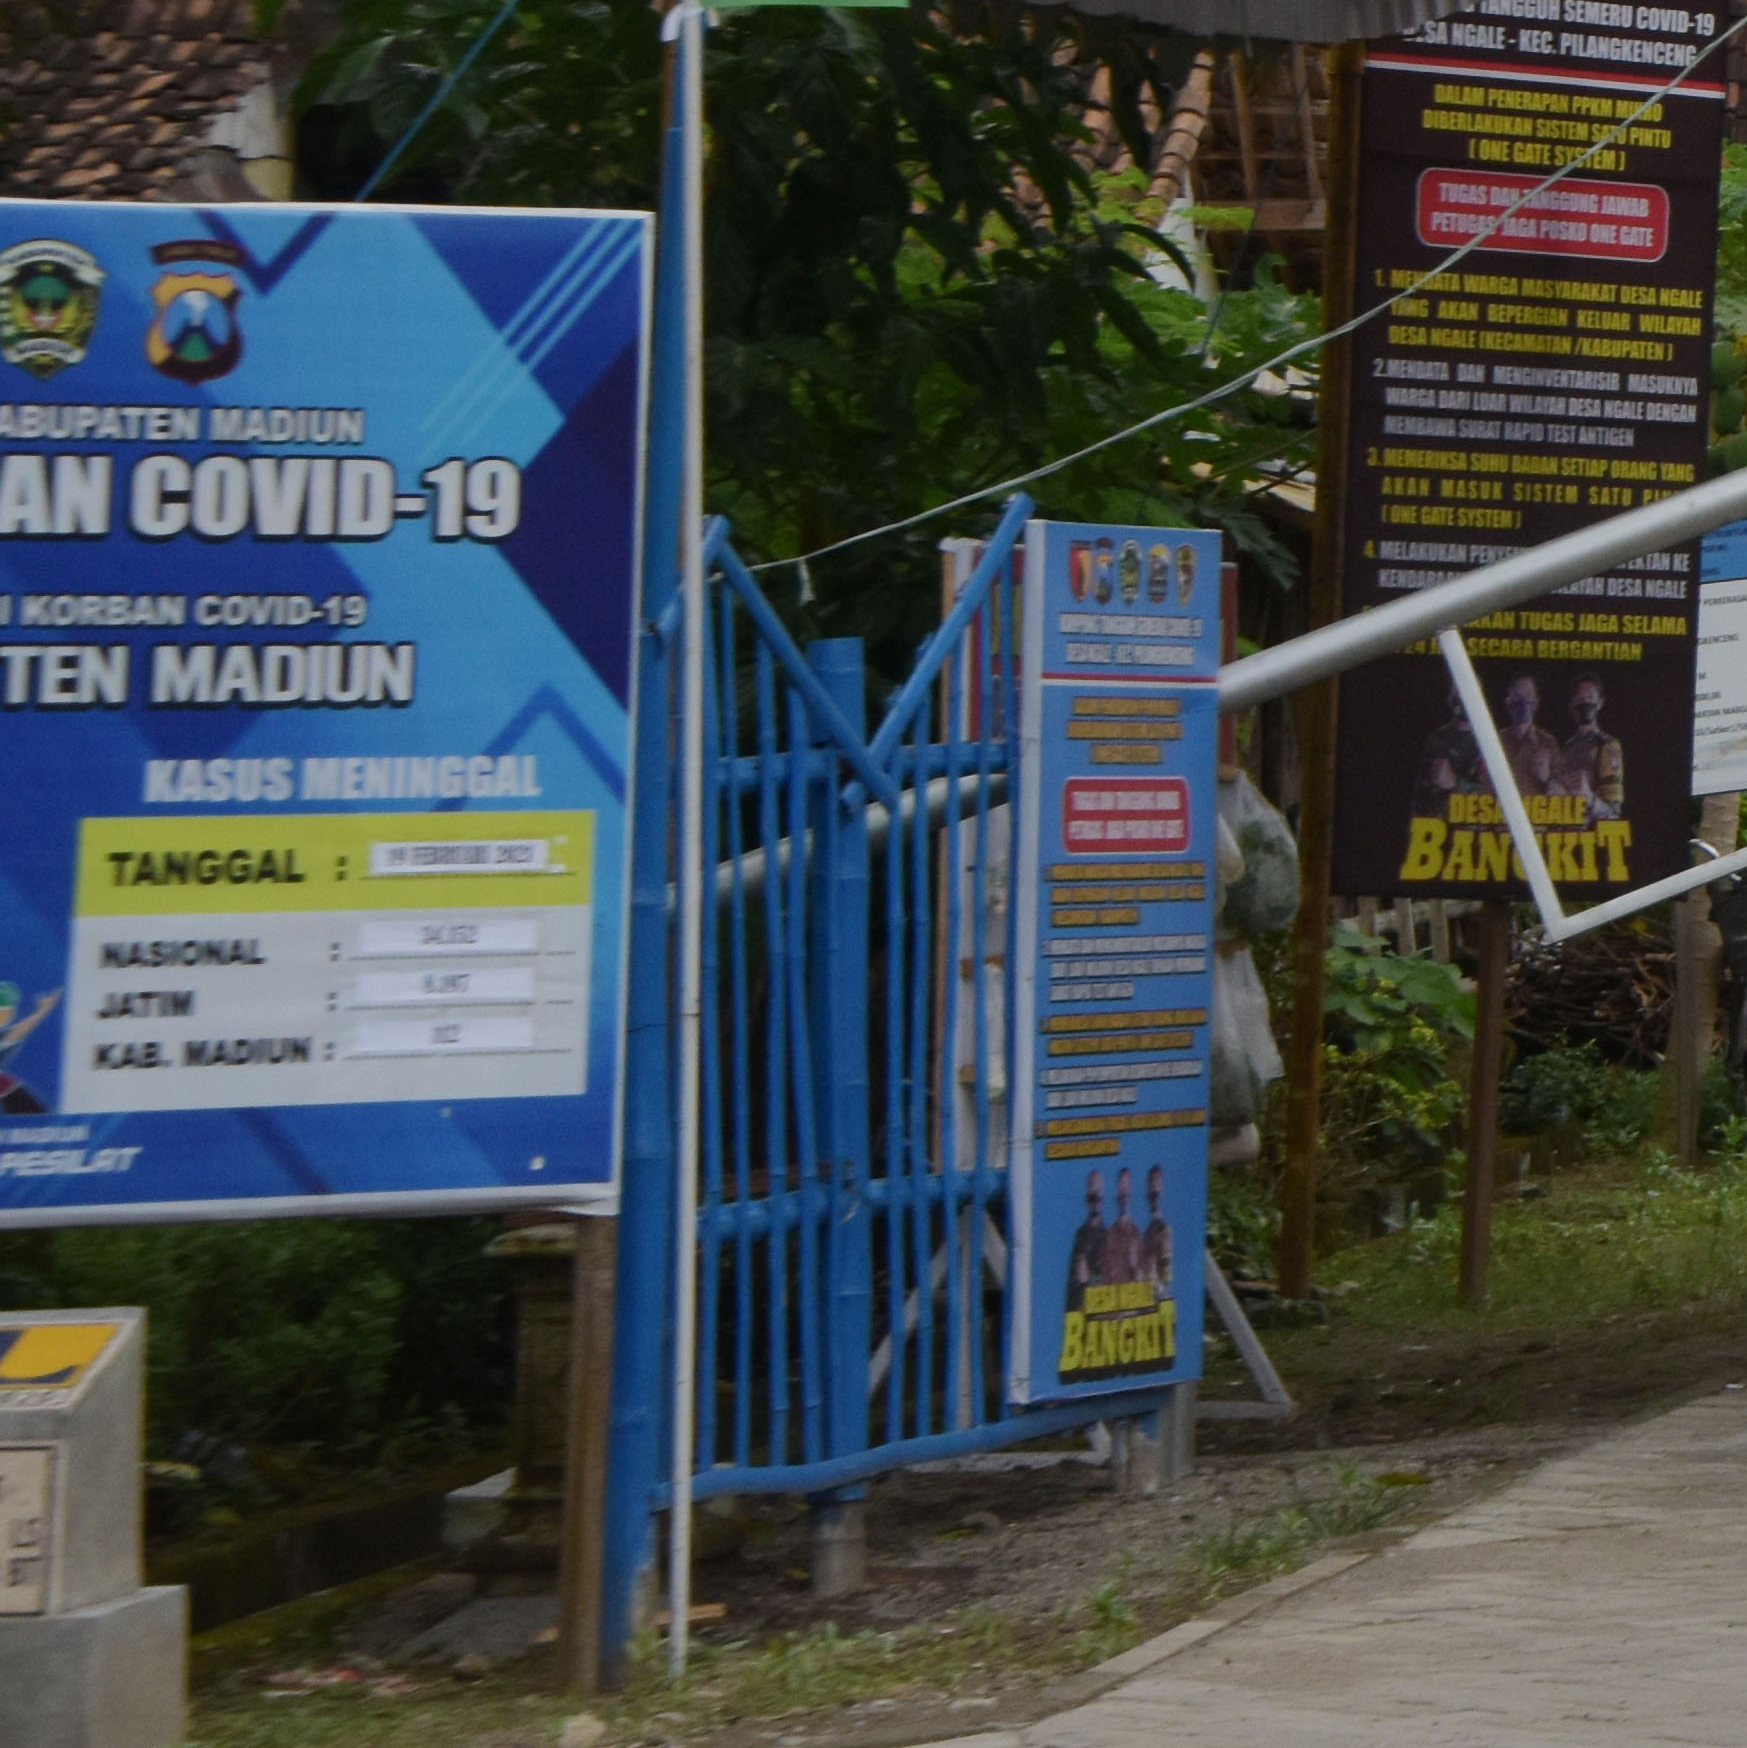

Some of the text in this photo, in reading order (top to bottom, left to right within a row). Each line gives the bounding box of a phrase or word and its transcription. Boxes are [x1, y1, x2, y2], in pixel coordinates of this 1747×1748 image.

[1636, 6, 1715, 37] COVID-19
[1452, 22, 1506, 50] NGALE
[1519, 30, 1557, 55] KEC.
[1559, 32, 1700, 68] PILANGKENCENG
[1433, 84, 1663, 123] DALAM PENERAPAN PPKM MIKRO
[1422, 109, 1672, 150] DIBERLAKUKAN SISTEM SATU PINTU
[1479, 140, 1617, 172] ONE GATE SYSTEM
[1439, 182, 1488, 206] TUGAS
[1522, 189, 1599, 214] TANGGUNG
[1601, 194, 1649, 218] JAWAB
[1431, 212, 1654, 248] PETUGAS JAGA POSKO ONE GATE
[1391, 269, 1461, 293] MENDATA
[1464, 273, 1519, 297] WARGA
[1522, 277, 1617, 302] MASYARAKAT
[1620, 286, 1656, 307] DESA
[1659, 288, 1704, 309] NGALE
[1392, 298, 1429, 319] YANG
[1437, 301, 1479, 322] AKAN
[1576, 309, 1631, 332] KELUAR
[1639, 314, 1702, 337] WILAYAH
[1388, 325, 1428, 346] DESA
[1430, 327, 1477, 349] NGALE
[1456, 362, 1486, 384] DAN
[1627, 374, 1699, 396] MASUKNYA
[1384, 387, 1698, 423] WARGA DARI LUAR WILAYAH DESA NGALE DENGAN
[209, 407, 365, 443] MADIUN
[1383, 415, 1634, 448] MEMBAWA SURAT RAPID TEST ANTIGEN
[1383, 448, 1468, 471] MEMERIKSA
[1470, 453, 1509, 473] SUHU
[1511, 455, 1559, 476] BADAN
[1561, 457, 1609, 478] SETIAP
[1610, 459, 1658, 481] ORANG
[1660, 462, 1695, 483] YANG
[131, 454, 522, 542] COVID-19
[1381, 476, 1431, 498] AKAN
[1440, 478, 1503, 500] MASUK
[1513, 482, 1579, 504] SISTEM
[1588, 486, 1633, 508] SATU
[1390, 505, 1514, 530] ONE GATE SYSTEM
[1379, 540, 1466, 564] MELAKUKAN
[1673, 553, 1691, 572] KE
[1606, 576, 1643, 598] DESA
[1645, 579, 1688, 599] NGALE
[20, 595, 186, 628] KORBAN
[194, 595, 368, 629] COVID-19
[1519, 611, 1575, 633] TUGAS
[1577, 613, 1619, 634] JAGA
[1621, 615, 1688, 637] SELAMA
[1470, 638, 1643, 662] SECARA BERGANTIAN
[149, 642, 415, 709] MADIUN
[143, 754, 543, 804] KASUS MENINGGAL
[107, 851, 306, 888] TANGGAL
[100, 939, 266, 969] NASIONAL
[96, 990, 195, 1020] JATIM
[93, 1037, 312, 1071] KAB. MADIUN
[1058, 1298, 1177, 1373] BANGKIT
